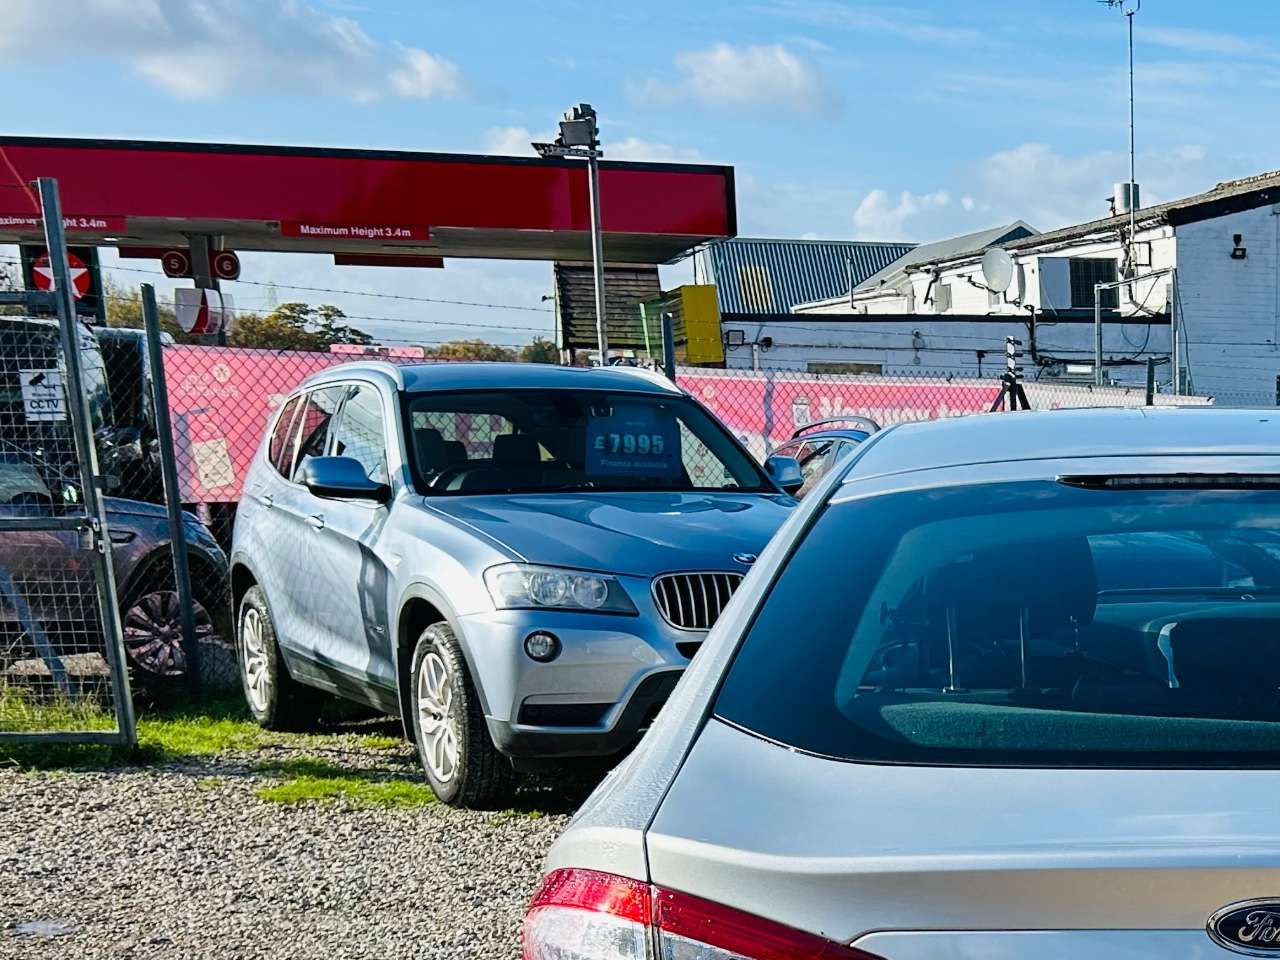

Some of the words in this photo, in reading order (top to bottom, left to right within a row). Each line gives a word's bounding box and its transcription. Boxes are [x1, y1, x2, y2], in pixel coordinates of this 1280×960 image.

[79, 218, 107, 228] 3.4m
[300, 225, 349, 235] Maximum
[351, 226, 384, 238] Height
[385, 227, 411, 237] 3.4m
[170, 258, 180, 269] 5
[222, 260, 232, 271] 6
[30, 400, 59, 409] CCTV
